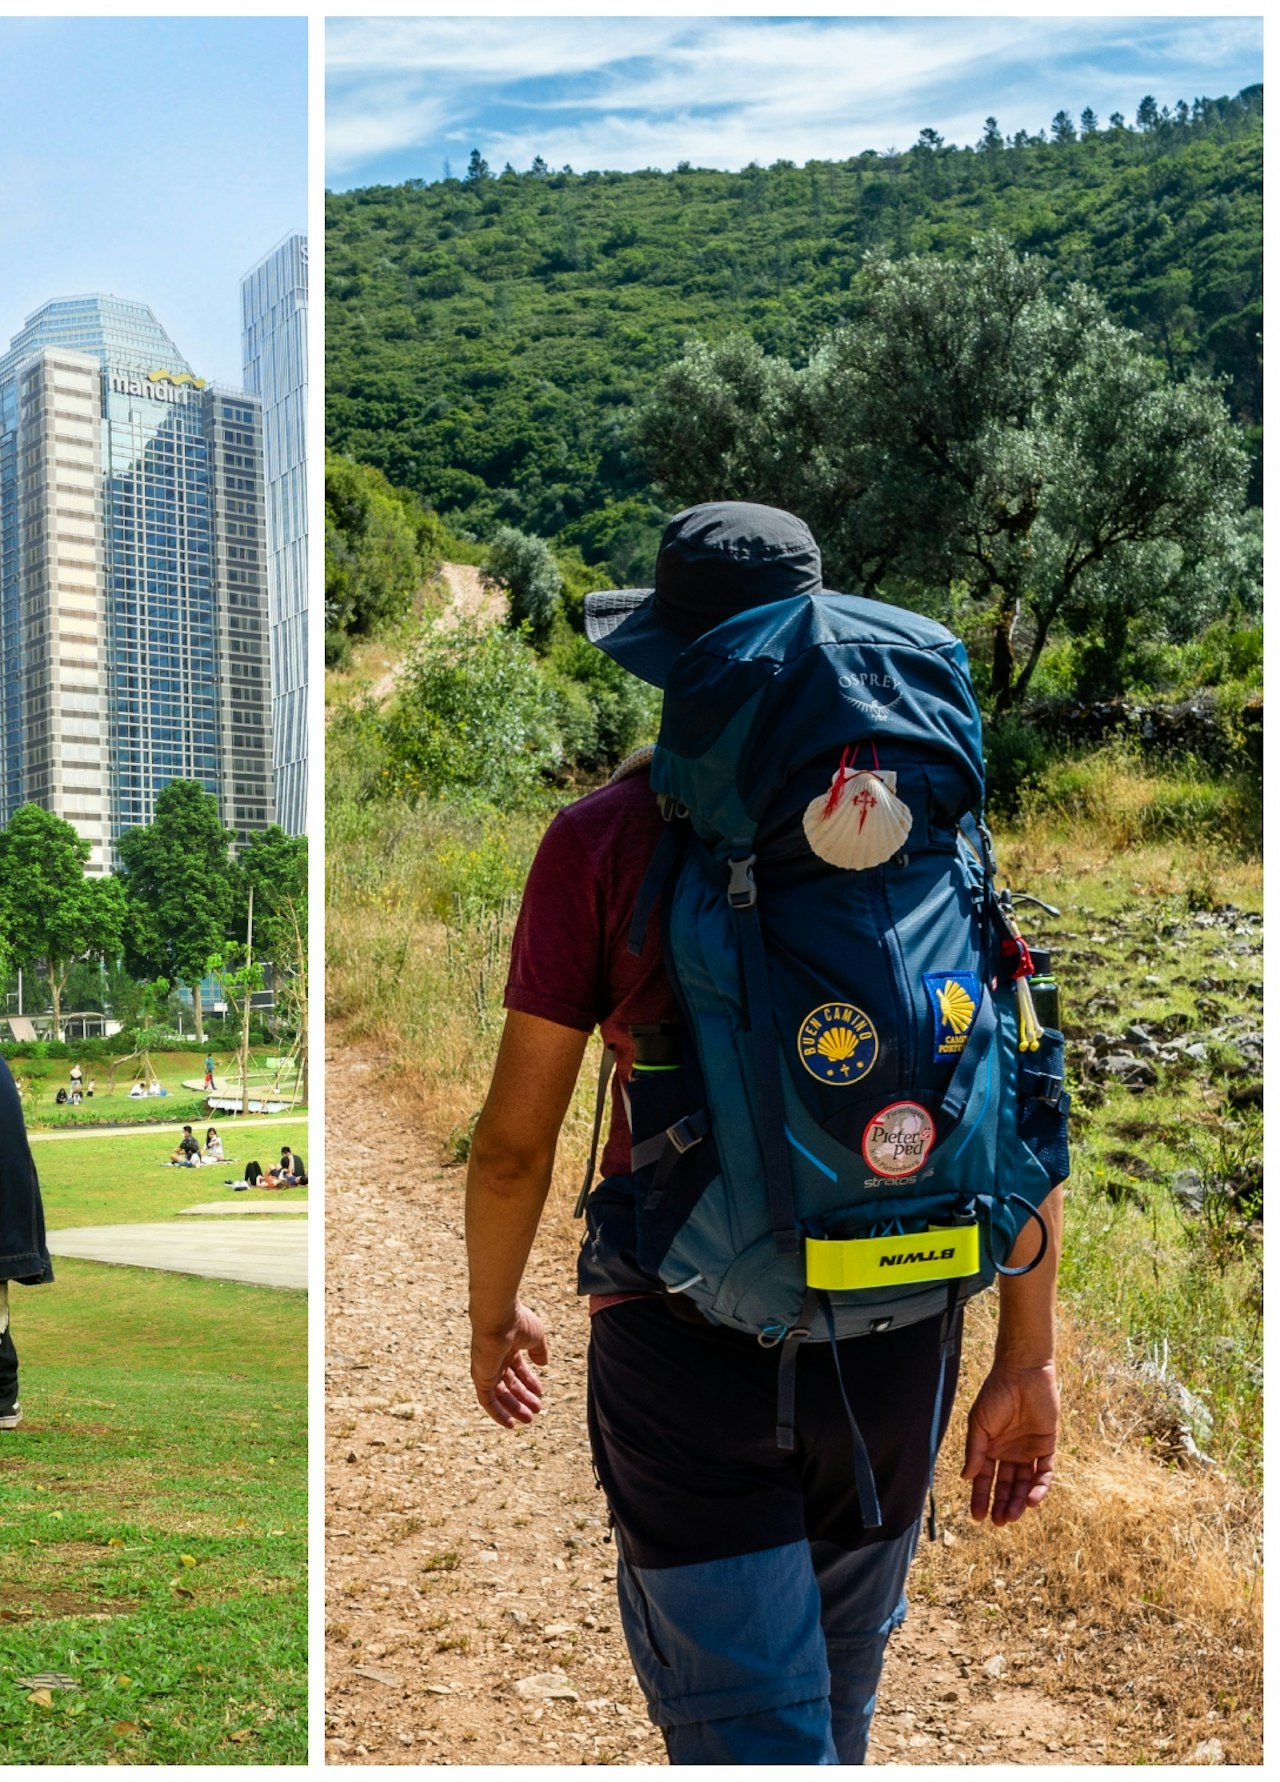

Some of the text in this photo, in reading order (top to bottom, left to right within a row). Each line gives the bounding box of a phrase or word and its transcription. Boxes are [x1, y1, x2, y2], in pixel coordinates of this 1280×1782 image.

[109, 373, 188, 404] mandiri
[839, 673, 901, 690] OSPREY
[802, 1007, 873, 1056] BUEN CAMINO
[872, 1126, 920, 1143] Pieter
[893, 1140, 924, 1160] ped
[864, 1176, 917, 1188] stratos
